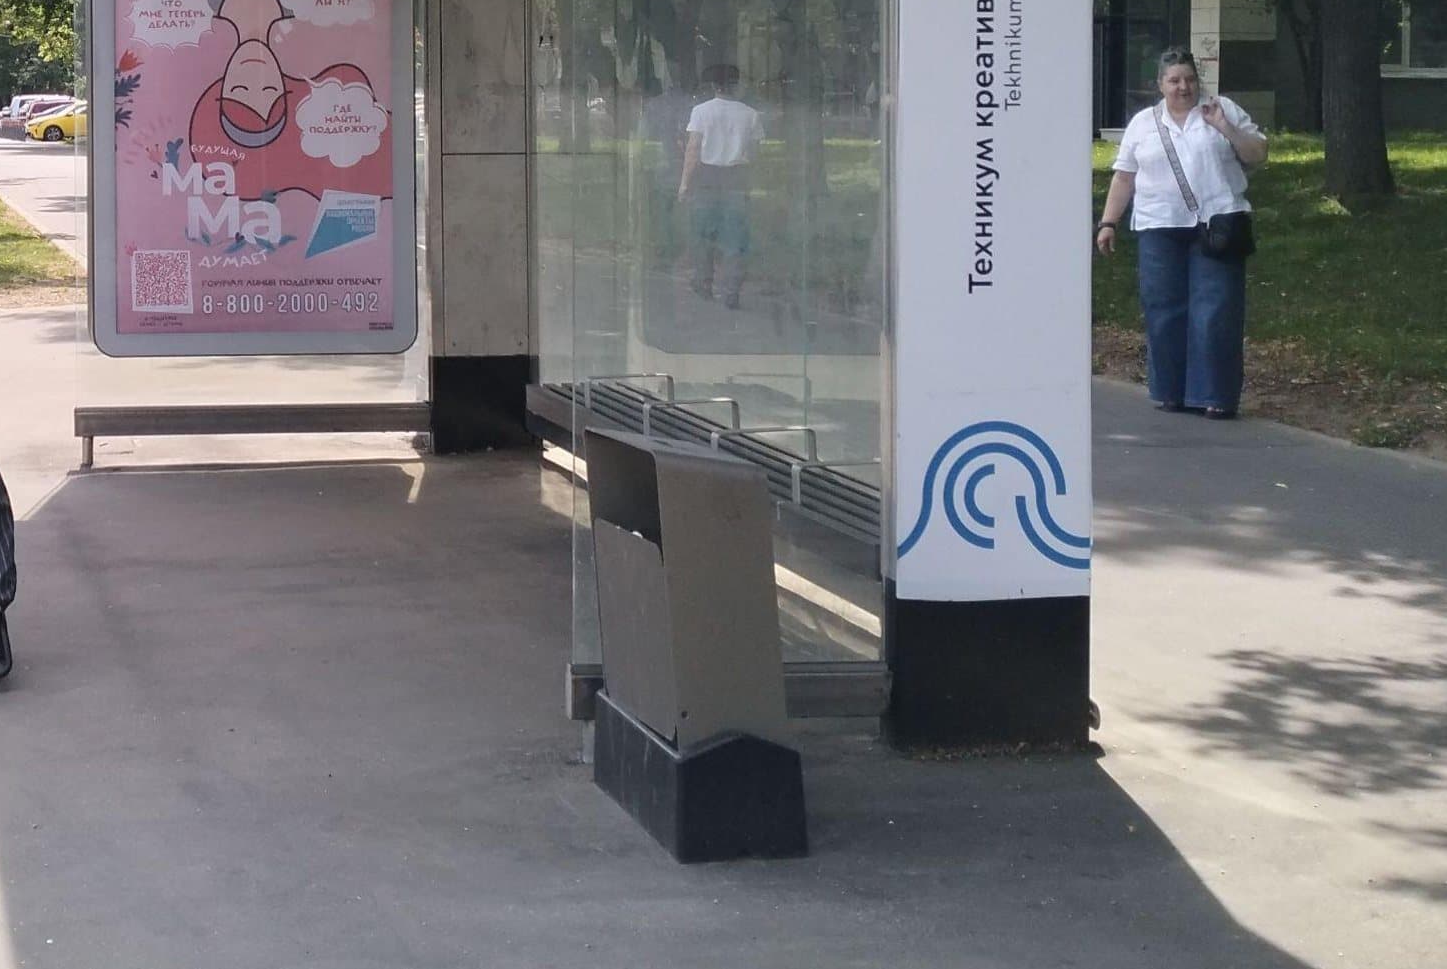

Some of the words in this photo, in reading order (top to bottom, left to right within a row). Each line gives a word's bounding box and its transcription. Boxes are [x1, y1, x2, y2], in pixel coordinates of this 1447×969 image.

[161, 0, 182, 7] ЧТО
[333, 104, 351, 112] ГДЕ
[969, 138, 1000, 294] Техникум
[199, 249, 267, 268] ДУМАЕТ
[202, 293, 378, 314] 8-800-2000-492
